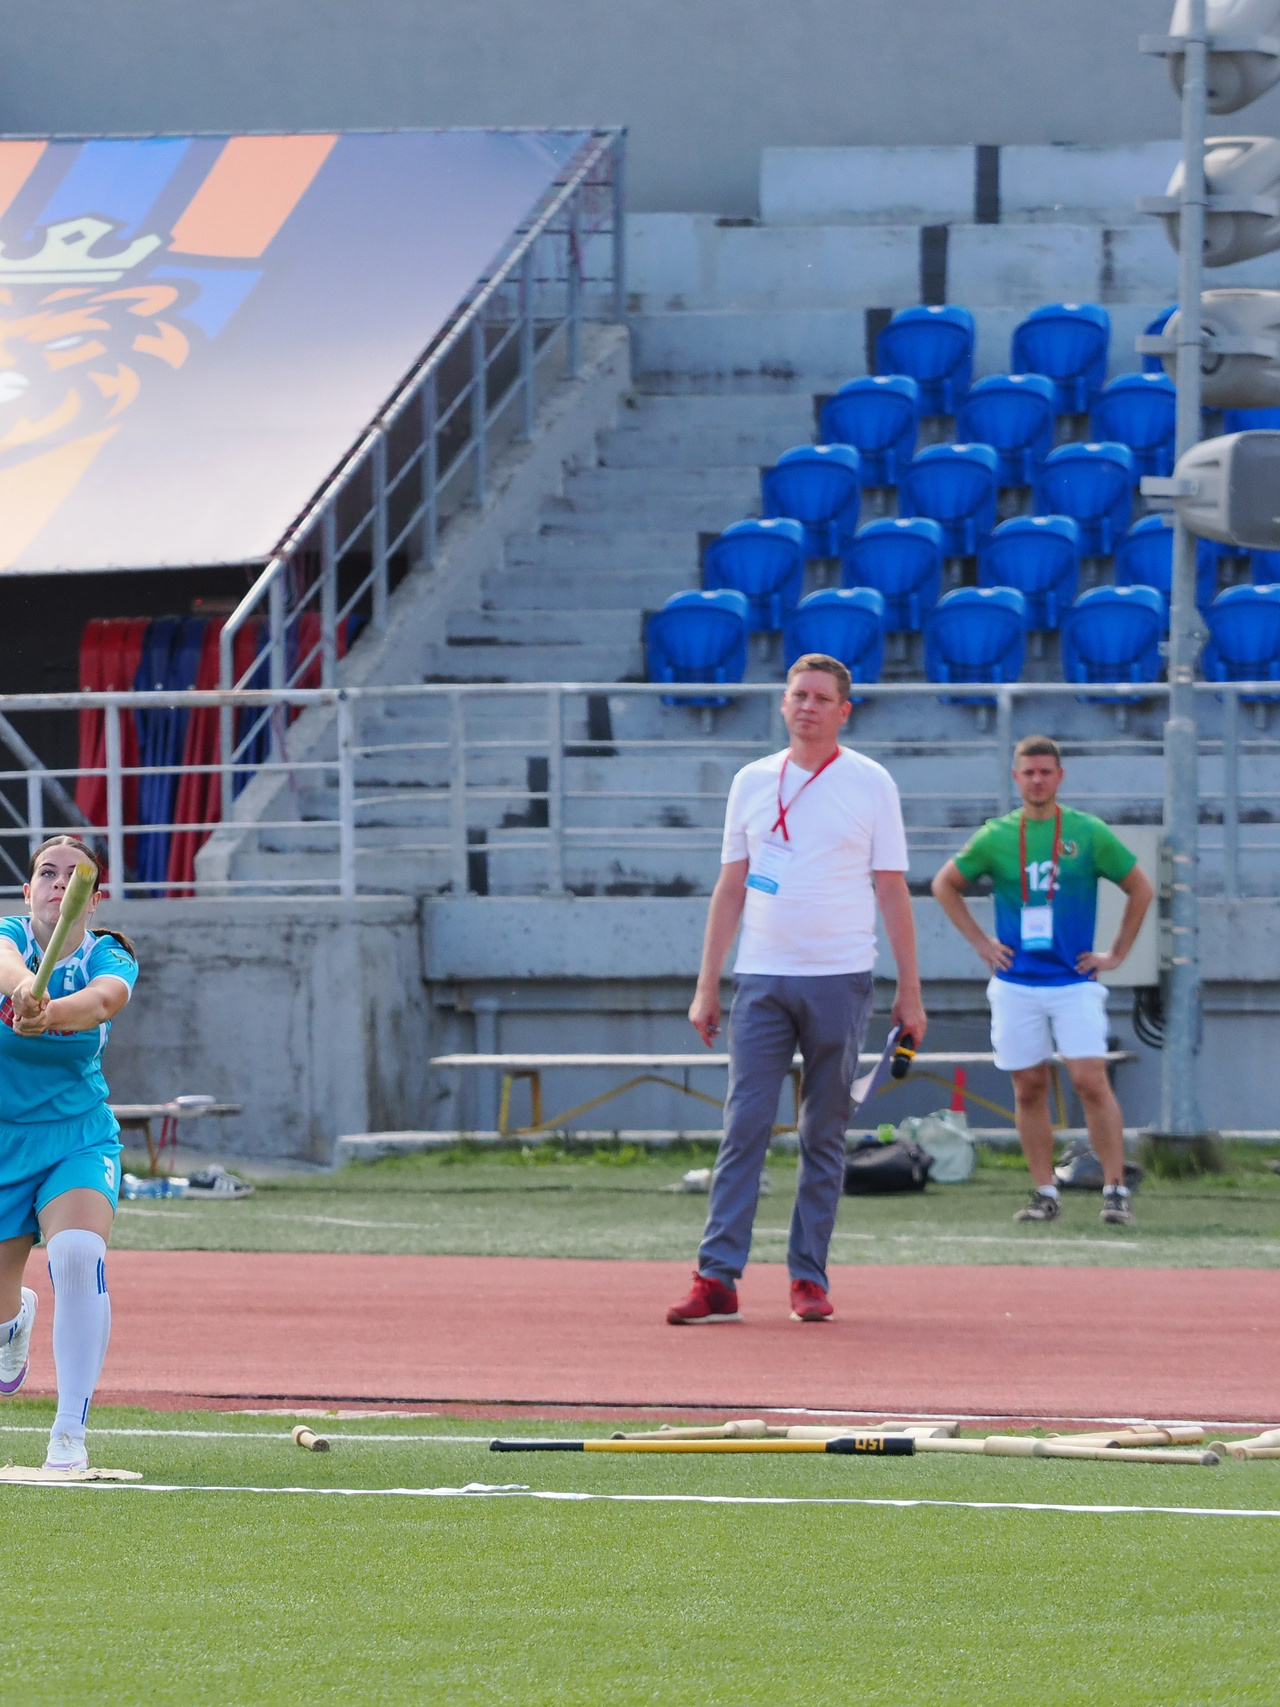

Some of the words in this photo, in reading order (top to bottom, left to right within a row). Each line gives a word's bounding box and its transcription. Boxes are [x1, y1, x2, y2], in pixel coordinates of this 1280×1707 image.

[1024, 860, 1061, 891] 12
[63, 956, 83, 991] 3
[103, 1154, 116, 1190] 3
